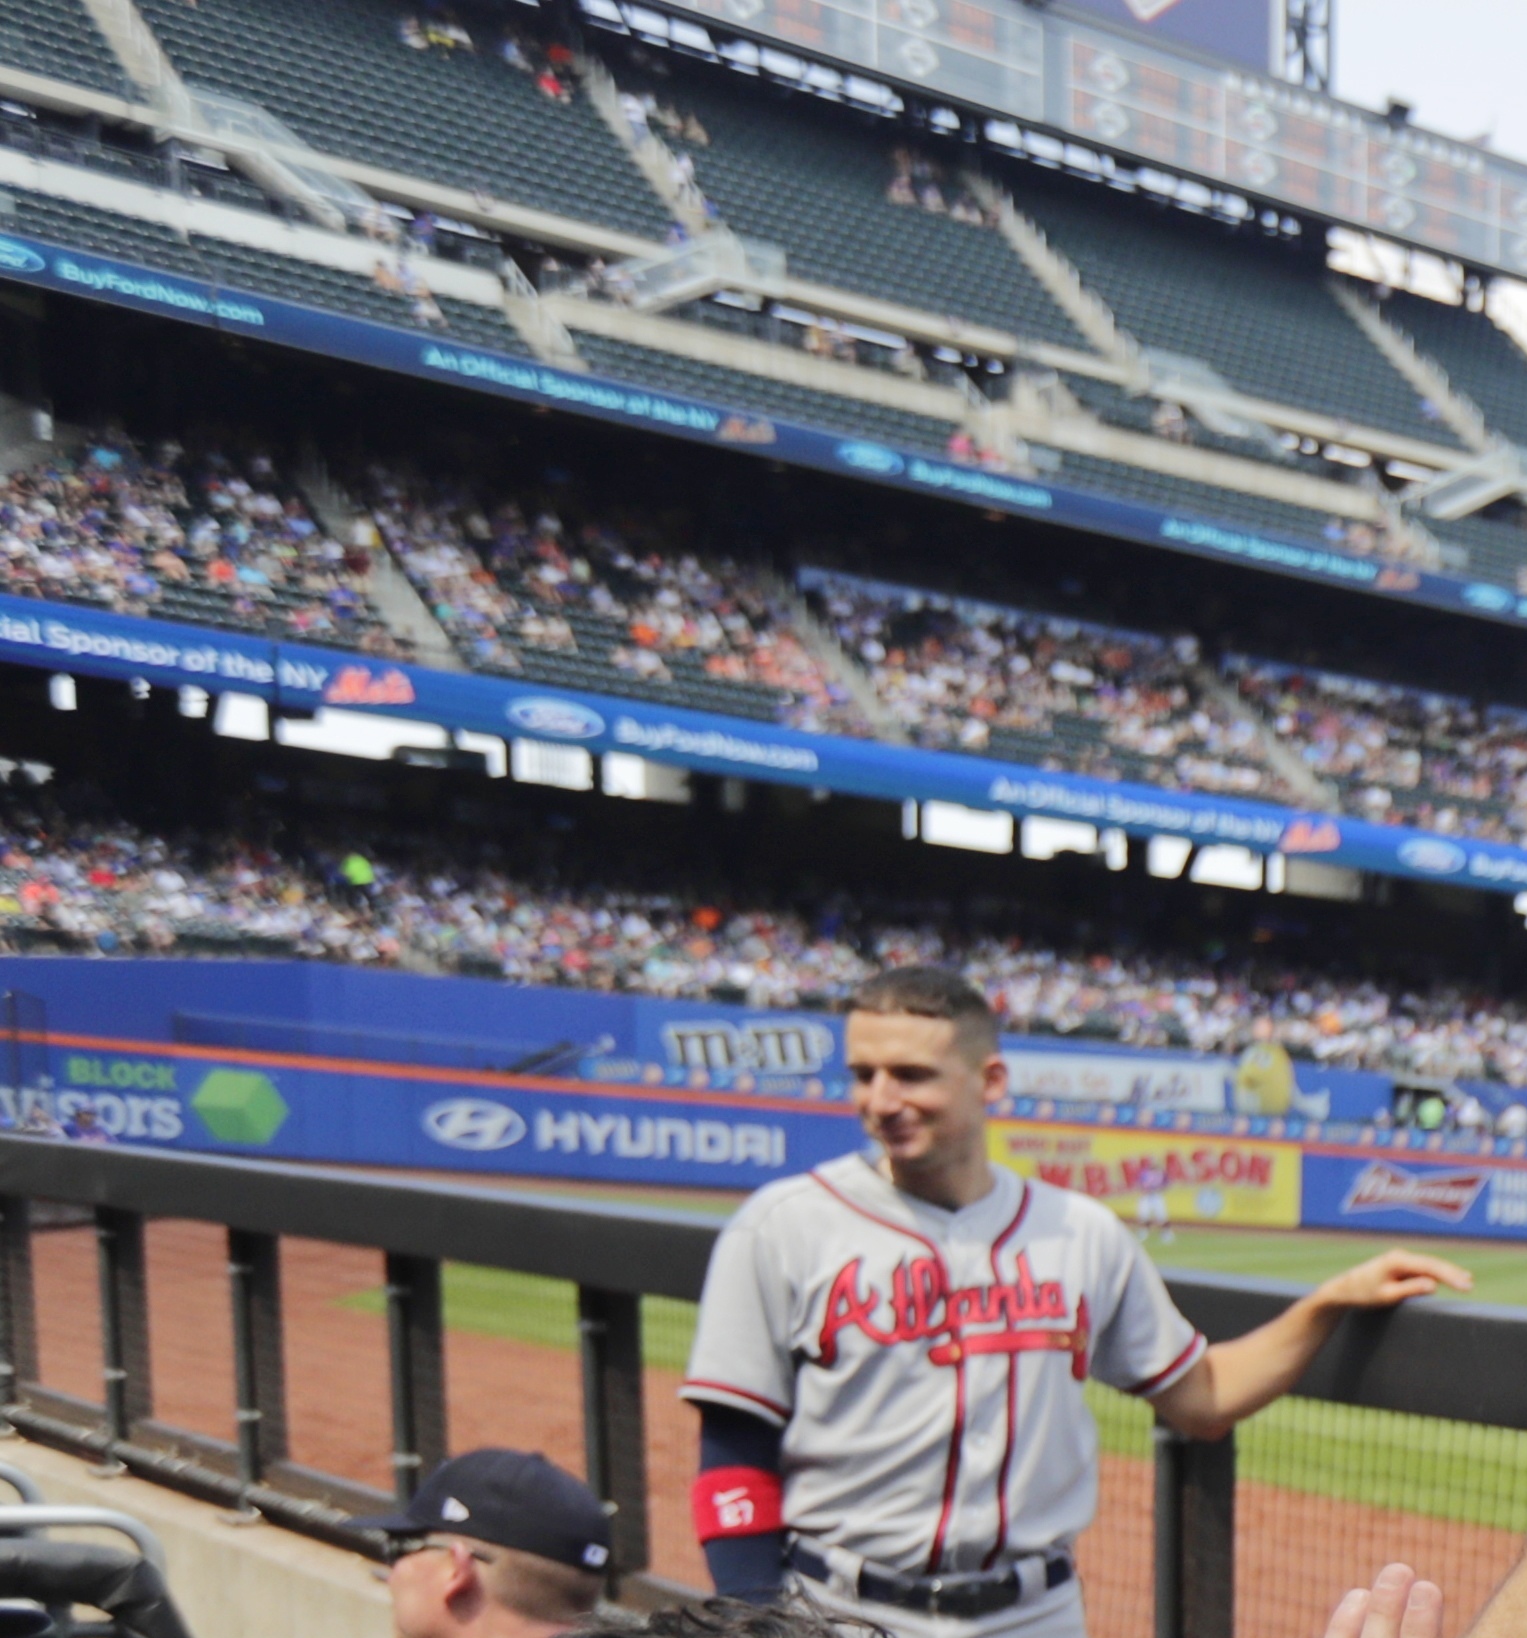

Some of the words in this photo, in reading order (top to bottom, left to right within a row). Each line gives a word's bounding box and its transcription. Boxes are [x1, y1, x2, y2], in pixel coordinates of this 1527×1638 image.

[45, 621, 181, 667] Sponsor
[180, 645, 218, 673] of
[218, 651, 275, 684] the
[277, 659, 329, 692] NY
[69, 1056, 176, 1090] BLOCK
[534, 1107, 787, 1168] HYUNDAI
[819, 1250, 1069, 1365] Atlanta
